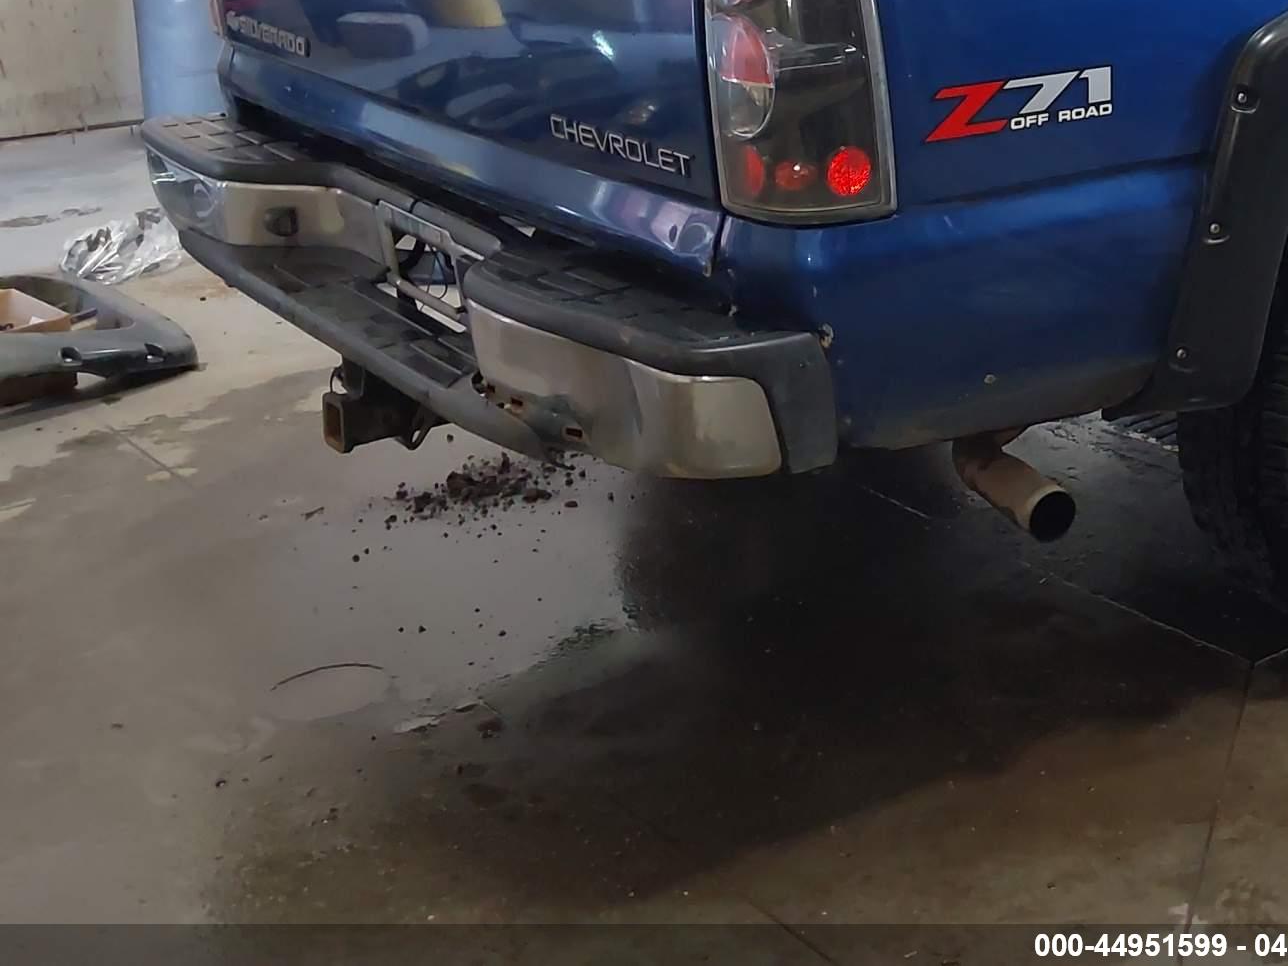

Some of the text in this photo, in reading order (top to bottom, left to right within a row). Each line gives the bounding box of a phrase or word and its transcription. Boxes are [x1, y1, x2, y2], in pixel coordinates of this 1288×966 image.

[925, 66, 1112, 142] Z71
[1010, 103, 1113, 130] OFF ROAD
[550, 115, 690, 176] CHEVROLET
